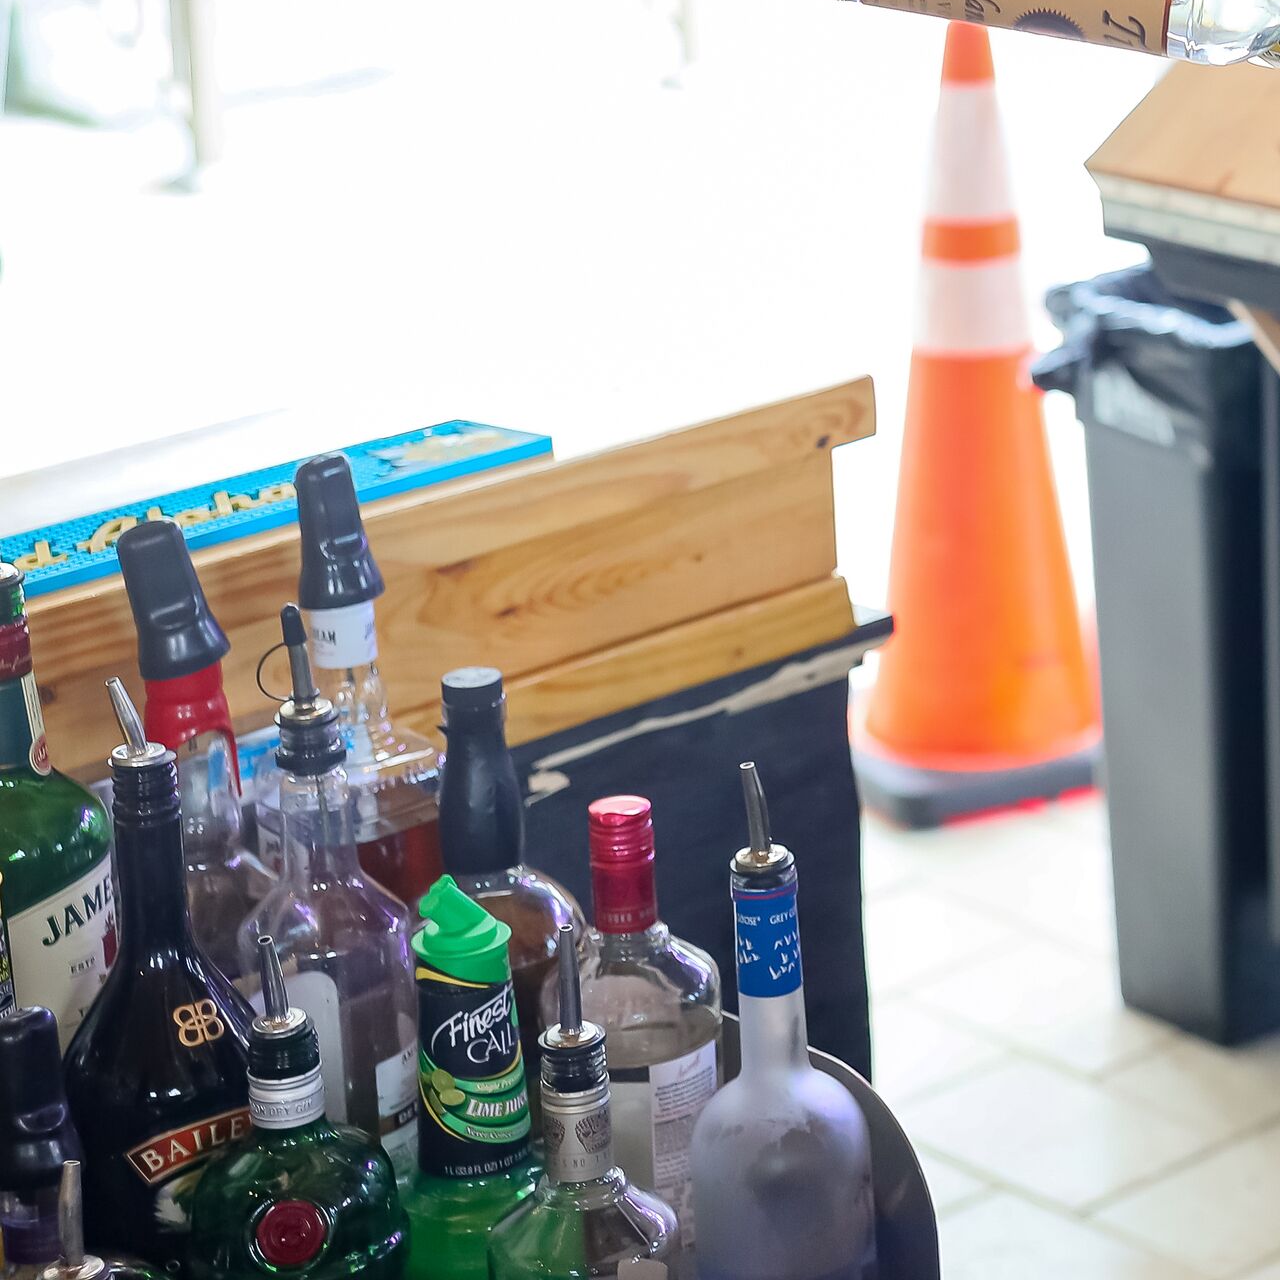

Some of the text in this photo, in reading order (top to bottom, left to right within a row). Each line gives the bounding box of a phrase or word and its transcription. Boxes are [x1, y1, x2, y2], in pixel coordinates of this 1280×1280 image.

[42, 874, 113, 948] JAME
[431, 981, 514, 1058] Finest
[466, 1022, 516, 1064] CALL
[465, 1098, 504, 1117] LIME
[140, 1116, 251, 1173] BAILE
